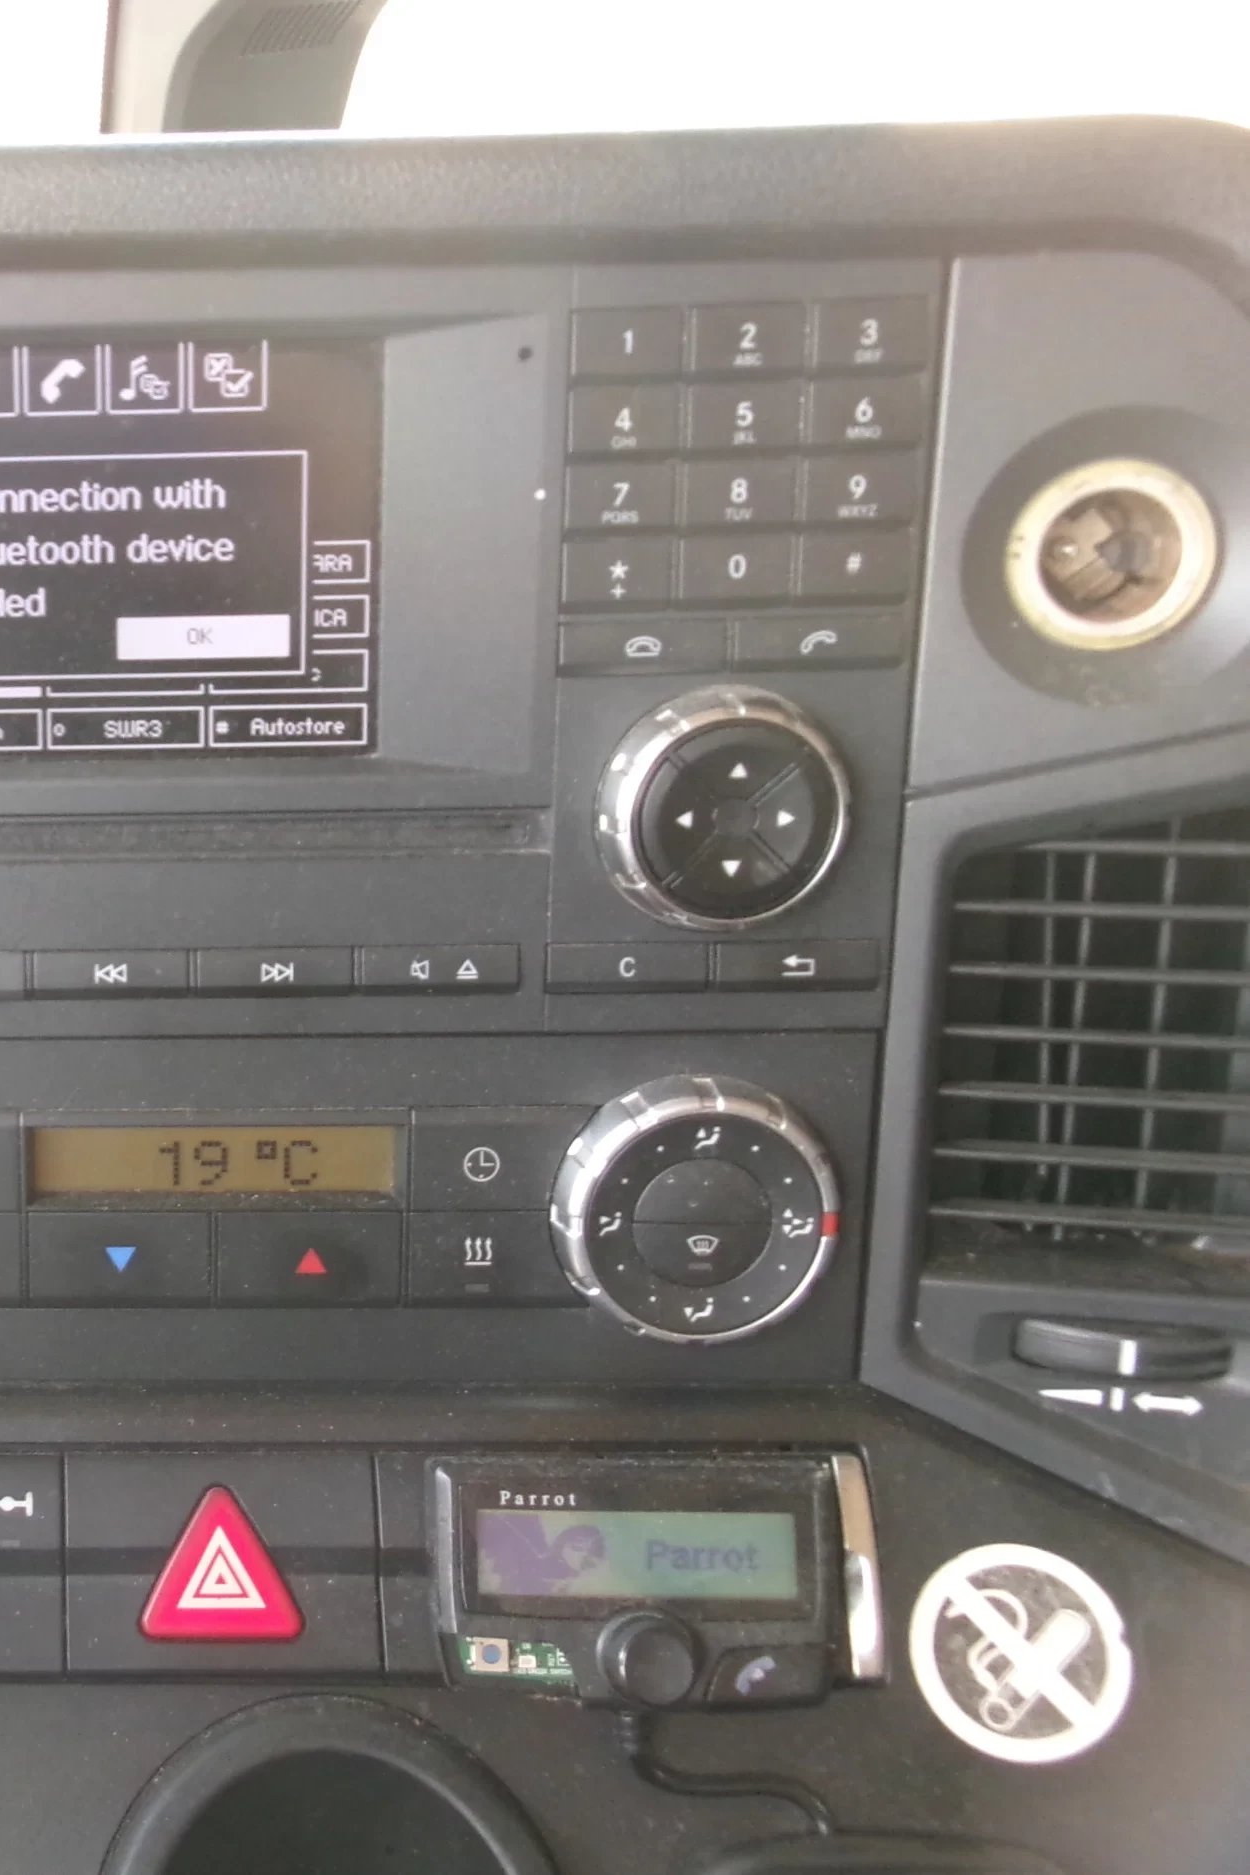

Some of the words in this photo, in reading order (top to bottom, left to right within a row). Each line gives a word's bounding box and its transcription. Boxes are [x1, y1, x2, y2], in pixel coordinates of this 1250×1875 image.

[622, 329, 634, 355] 1
[739, 321, 758, 350] 2
[859, 318, 880, 346] 3
[614, 407, 633, 433] 4
[735, 401, 755, 427] 5
[854, 397, 874, 423] 6
[154, 478, 227, 510] with
[612, 483, 631, 507] 7
[730, 478, 749, 503] 8
[848, 474, 868, 499] 9
[127, 533, 235, 564] device
[728, 554, 747, 579] 0
[186, 629, 214, 645] OK
[250, 716, 346, 737] Autostore
[618, 956, 637, 979] C
[159, 1140, 227, 1186] 19
[499, 1490, 577, 1507] Parrot
[646, 1538, 760, 1572] Parrot
